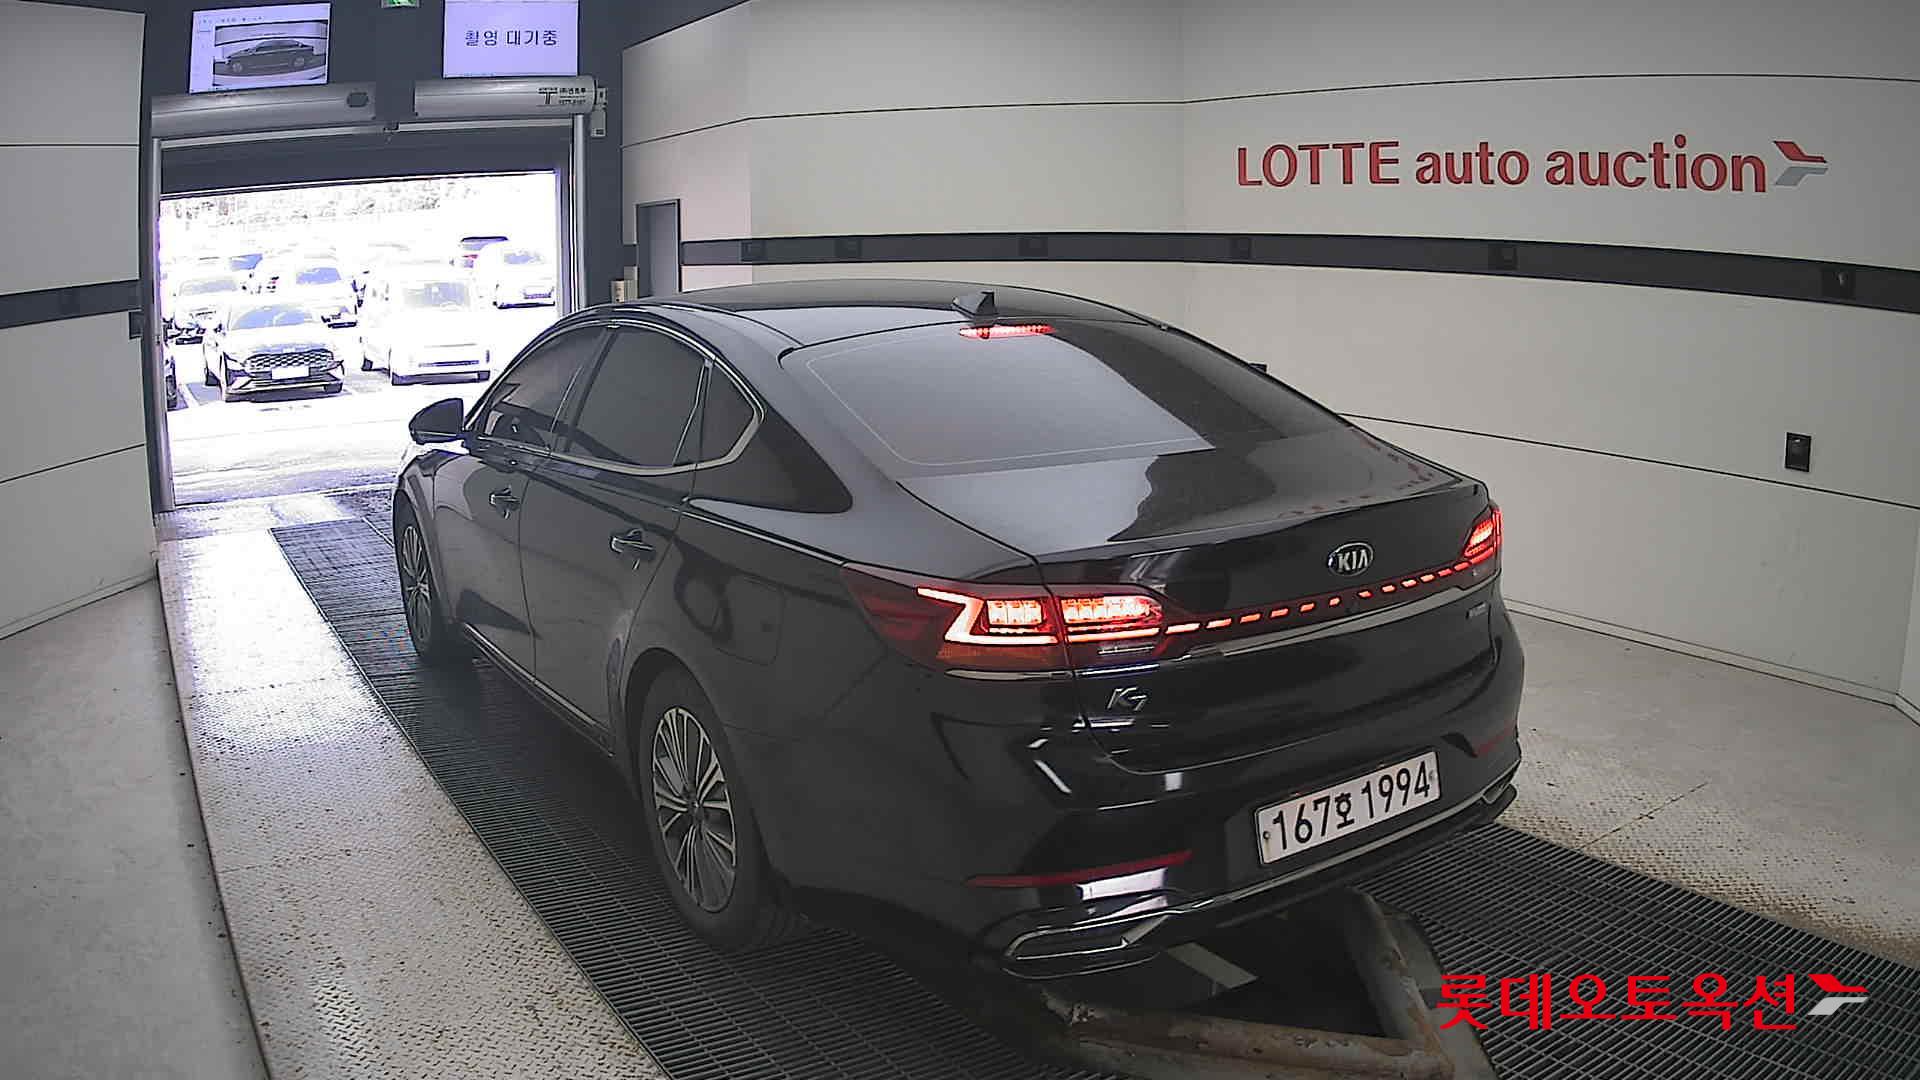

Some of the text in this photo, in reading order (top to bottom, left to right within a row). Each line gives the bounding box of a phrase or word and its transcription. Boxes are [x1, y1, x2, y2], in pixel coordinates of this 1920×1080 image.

[506, 30, 557, 46] 대기중
[1237, 134, 1767, 193] LOTTE auto auction
[1337, 548, 1368, 573] KIA
[1107, 687, 1147, 711] K7
[1272, 760, 1430, 850] 167호 1994
